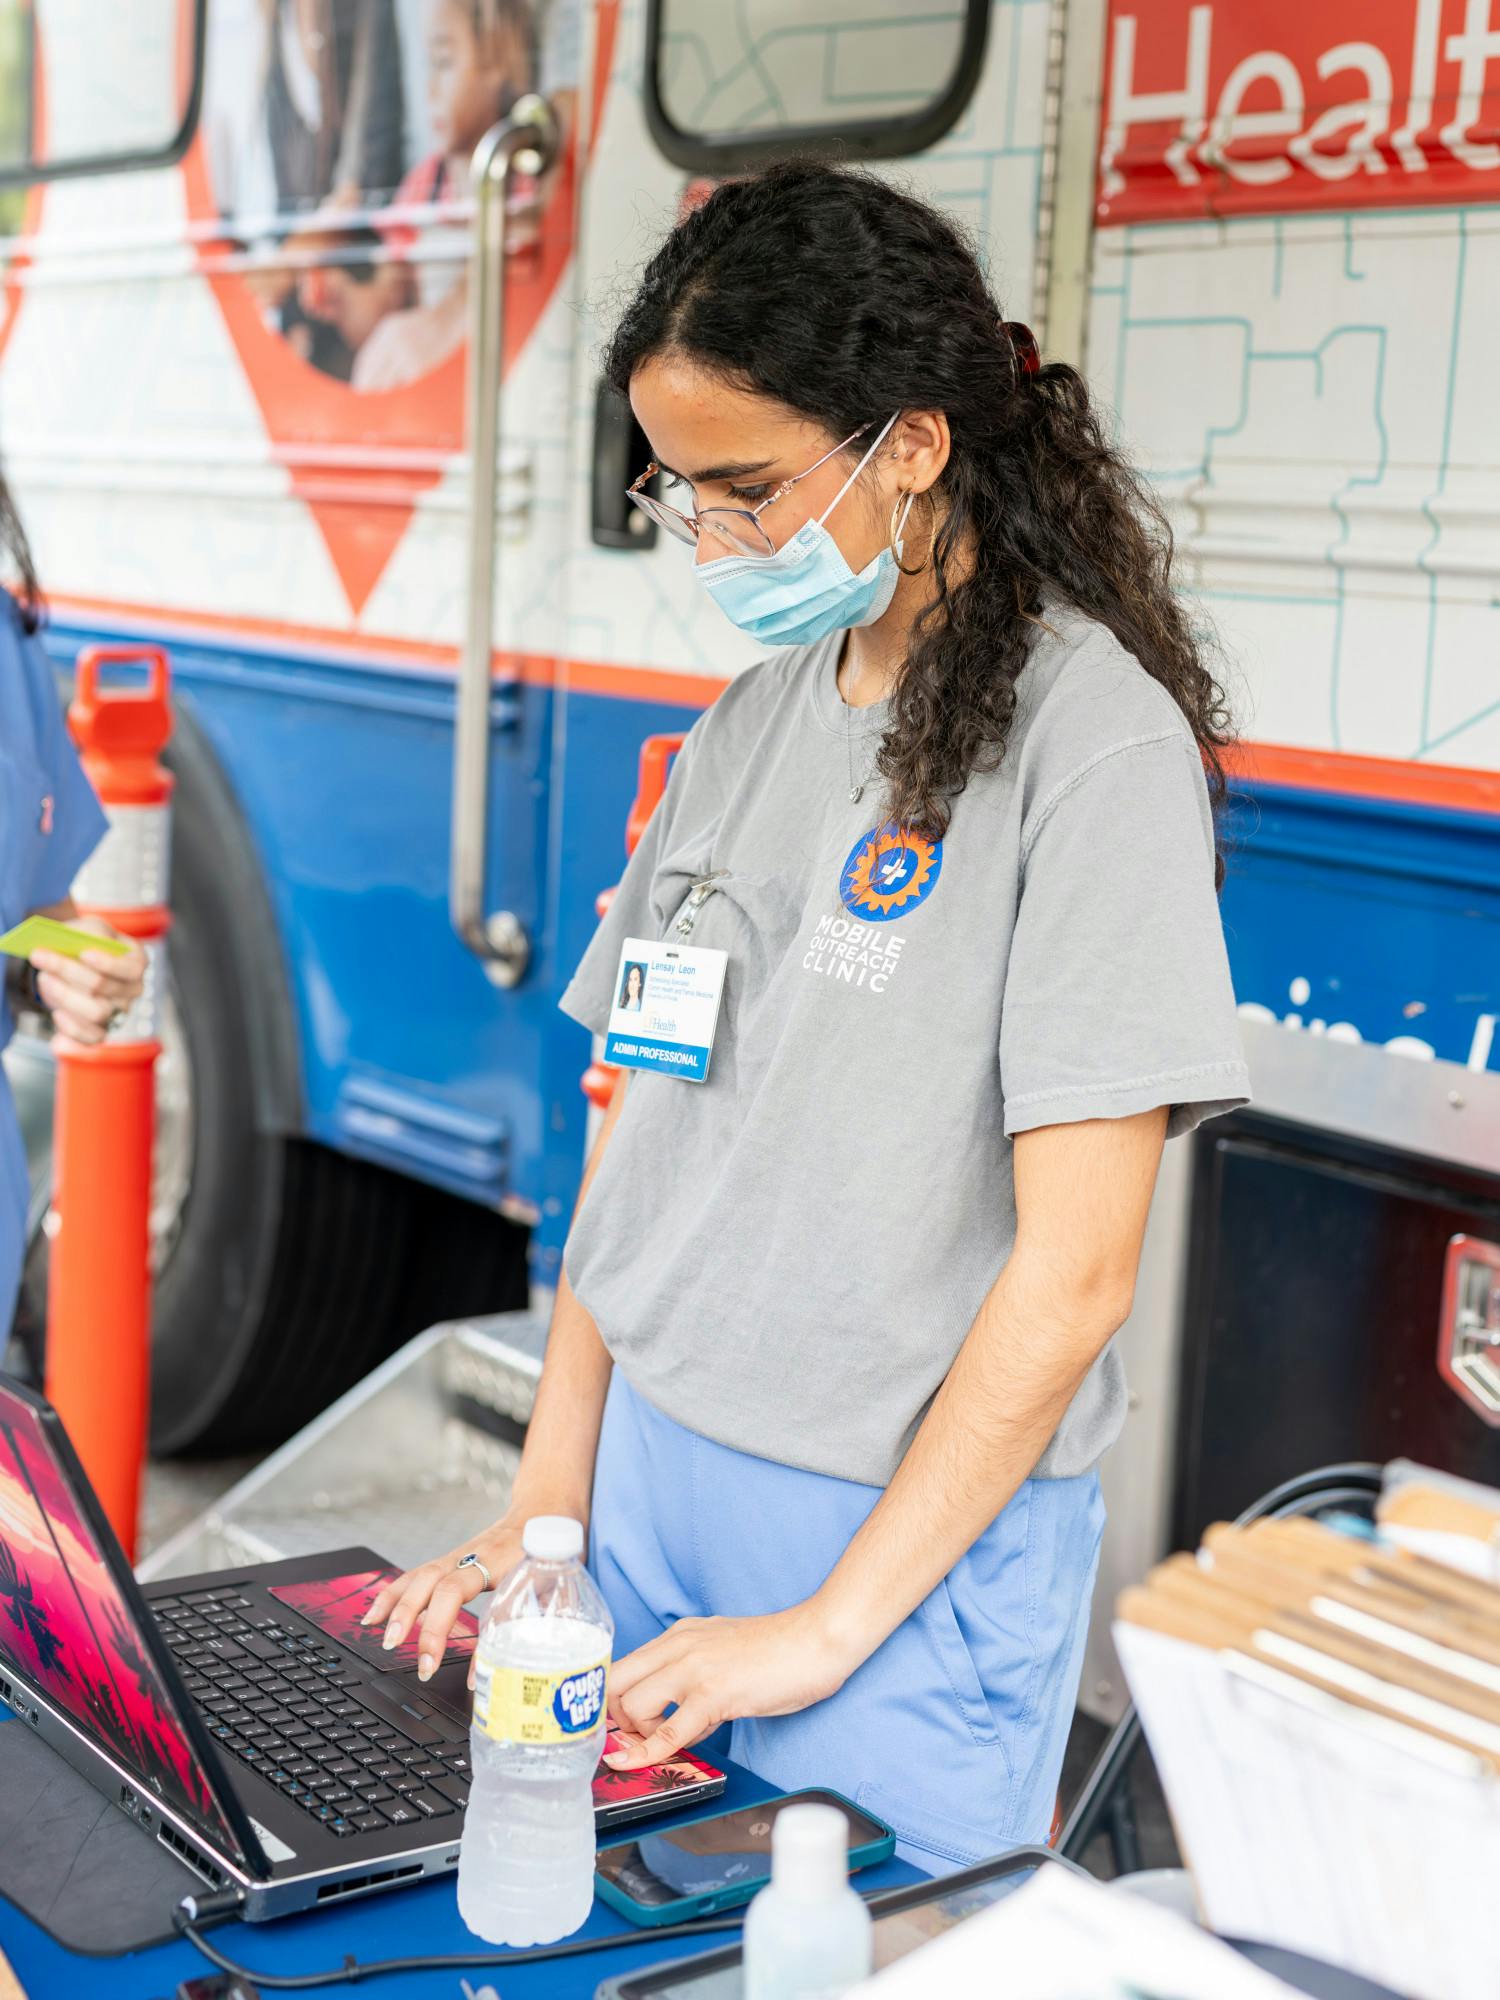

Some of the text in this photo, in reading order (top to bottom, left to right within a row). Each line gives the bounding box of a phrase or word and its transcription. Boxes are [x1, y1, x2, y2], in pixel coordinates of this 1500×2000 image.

[809, 935, 898, 975] OUTREACH
[814, 914, 906, 960] MOBILE
[679, 964, 696, 975] Leon
[802, 951, 889, 993] CLINIC
[612, 1041, 699, 1067] ADMIN PROFESSIONAL
